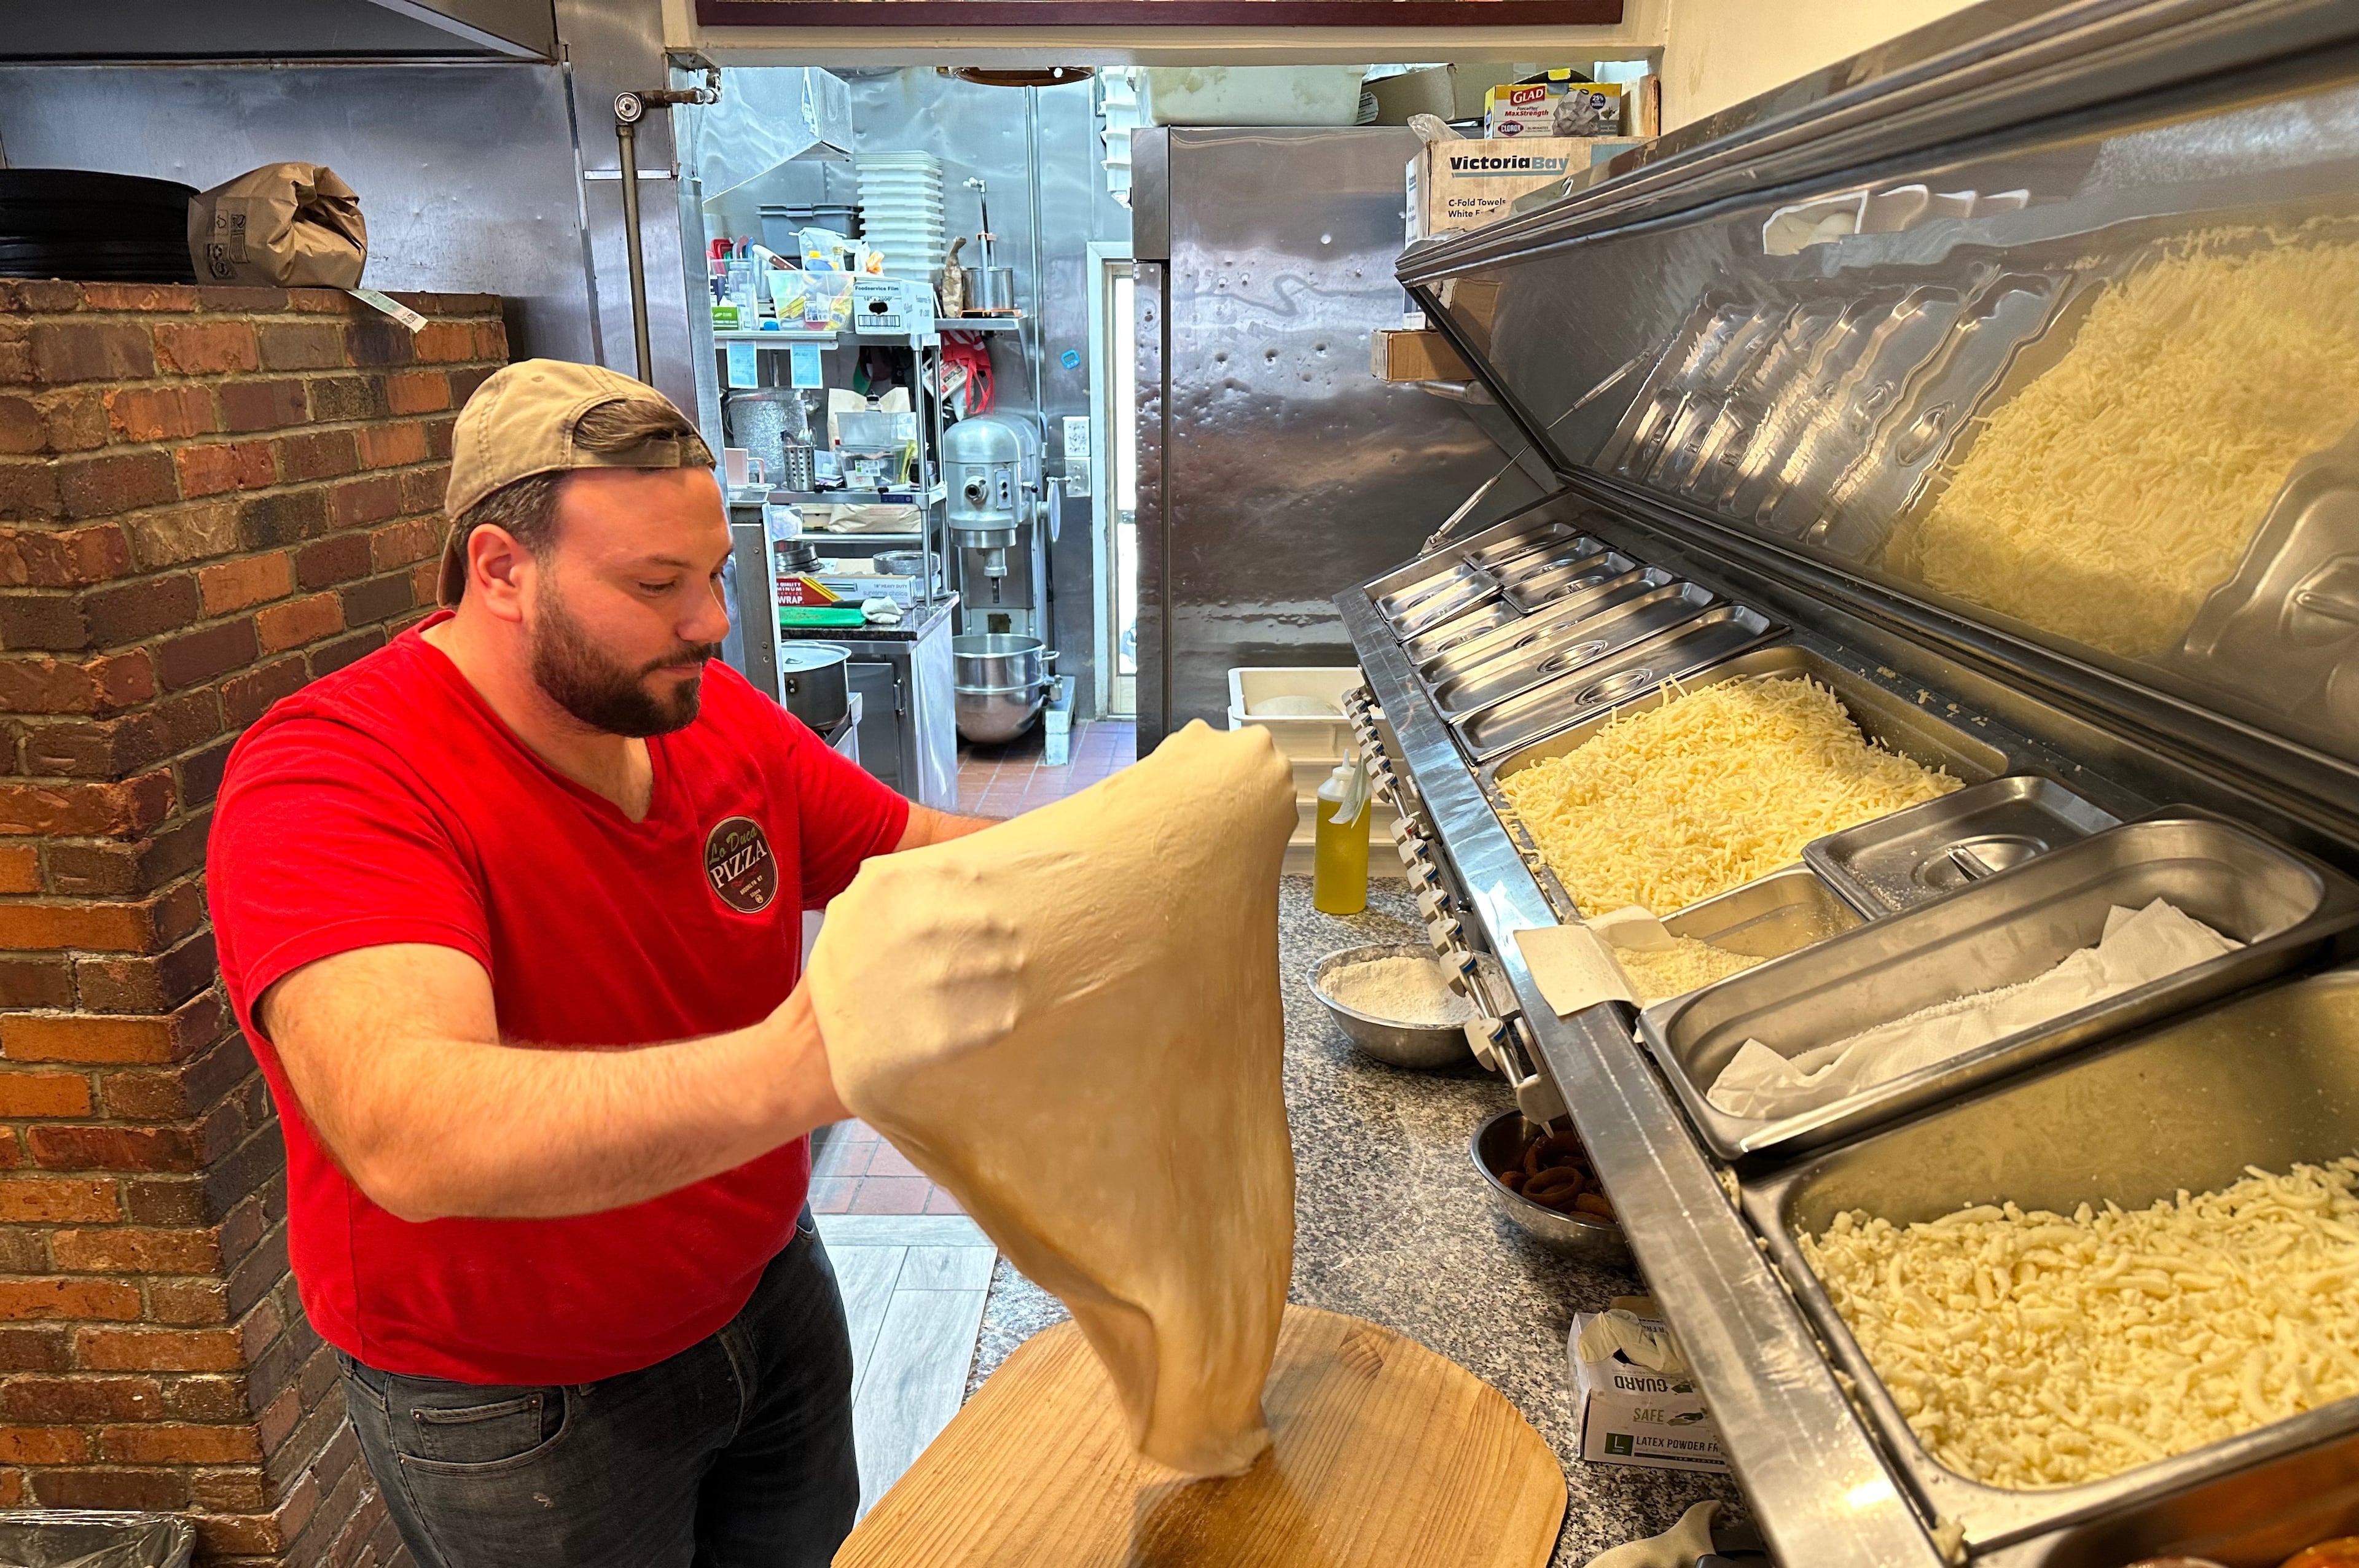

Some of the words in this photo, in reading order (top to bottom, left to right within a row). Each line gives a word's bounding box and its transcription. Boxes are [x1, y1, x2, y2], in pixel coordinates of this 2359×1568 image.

[1513, 88, 1544, 104] GLAD
[1501, 124, 1521, 133] CLOROX
[710, 840, 767, 889] PIZZA
[1614, 1375, 1668, 1392] GUARD
[1633, 1408, 1665, 1422] SAFE
[1636, 1436, 1664, 1448] LATEX
[1667, 1439, 1705, 1451] POWDER
[1707, 1442, 1719, 1452] FR
